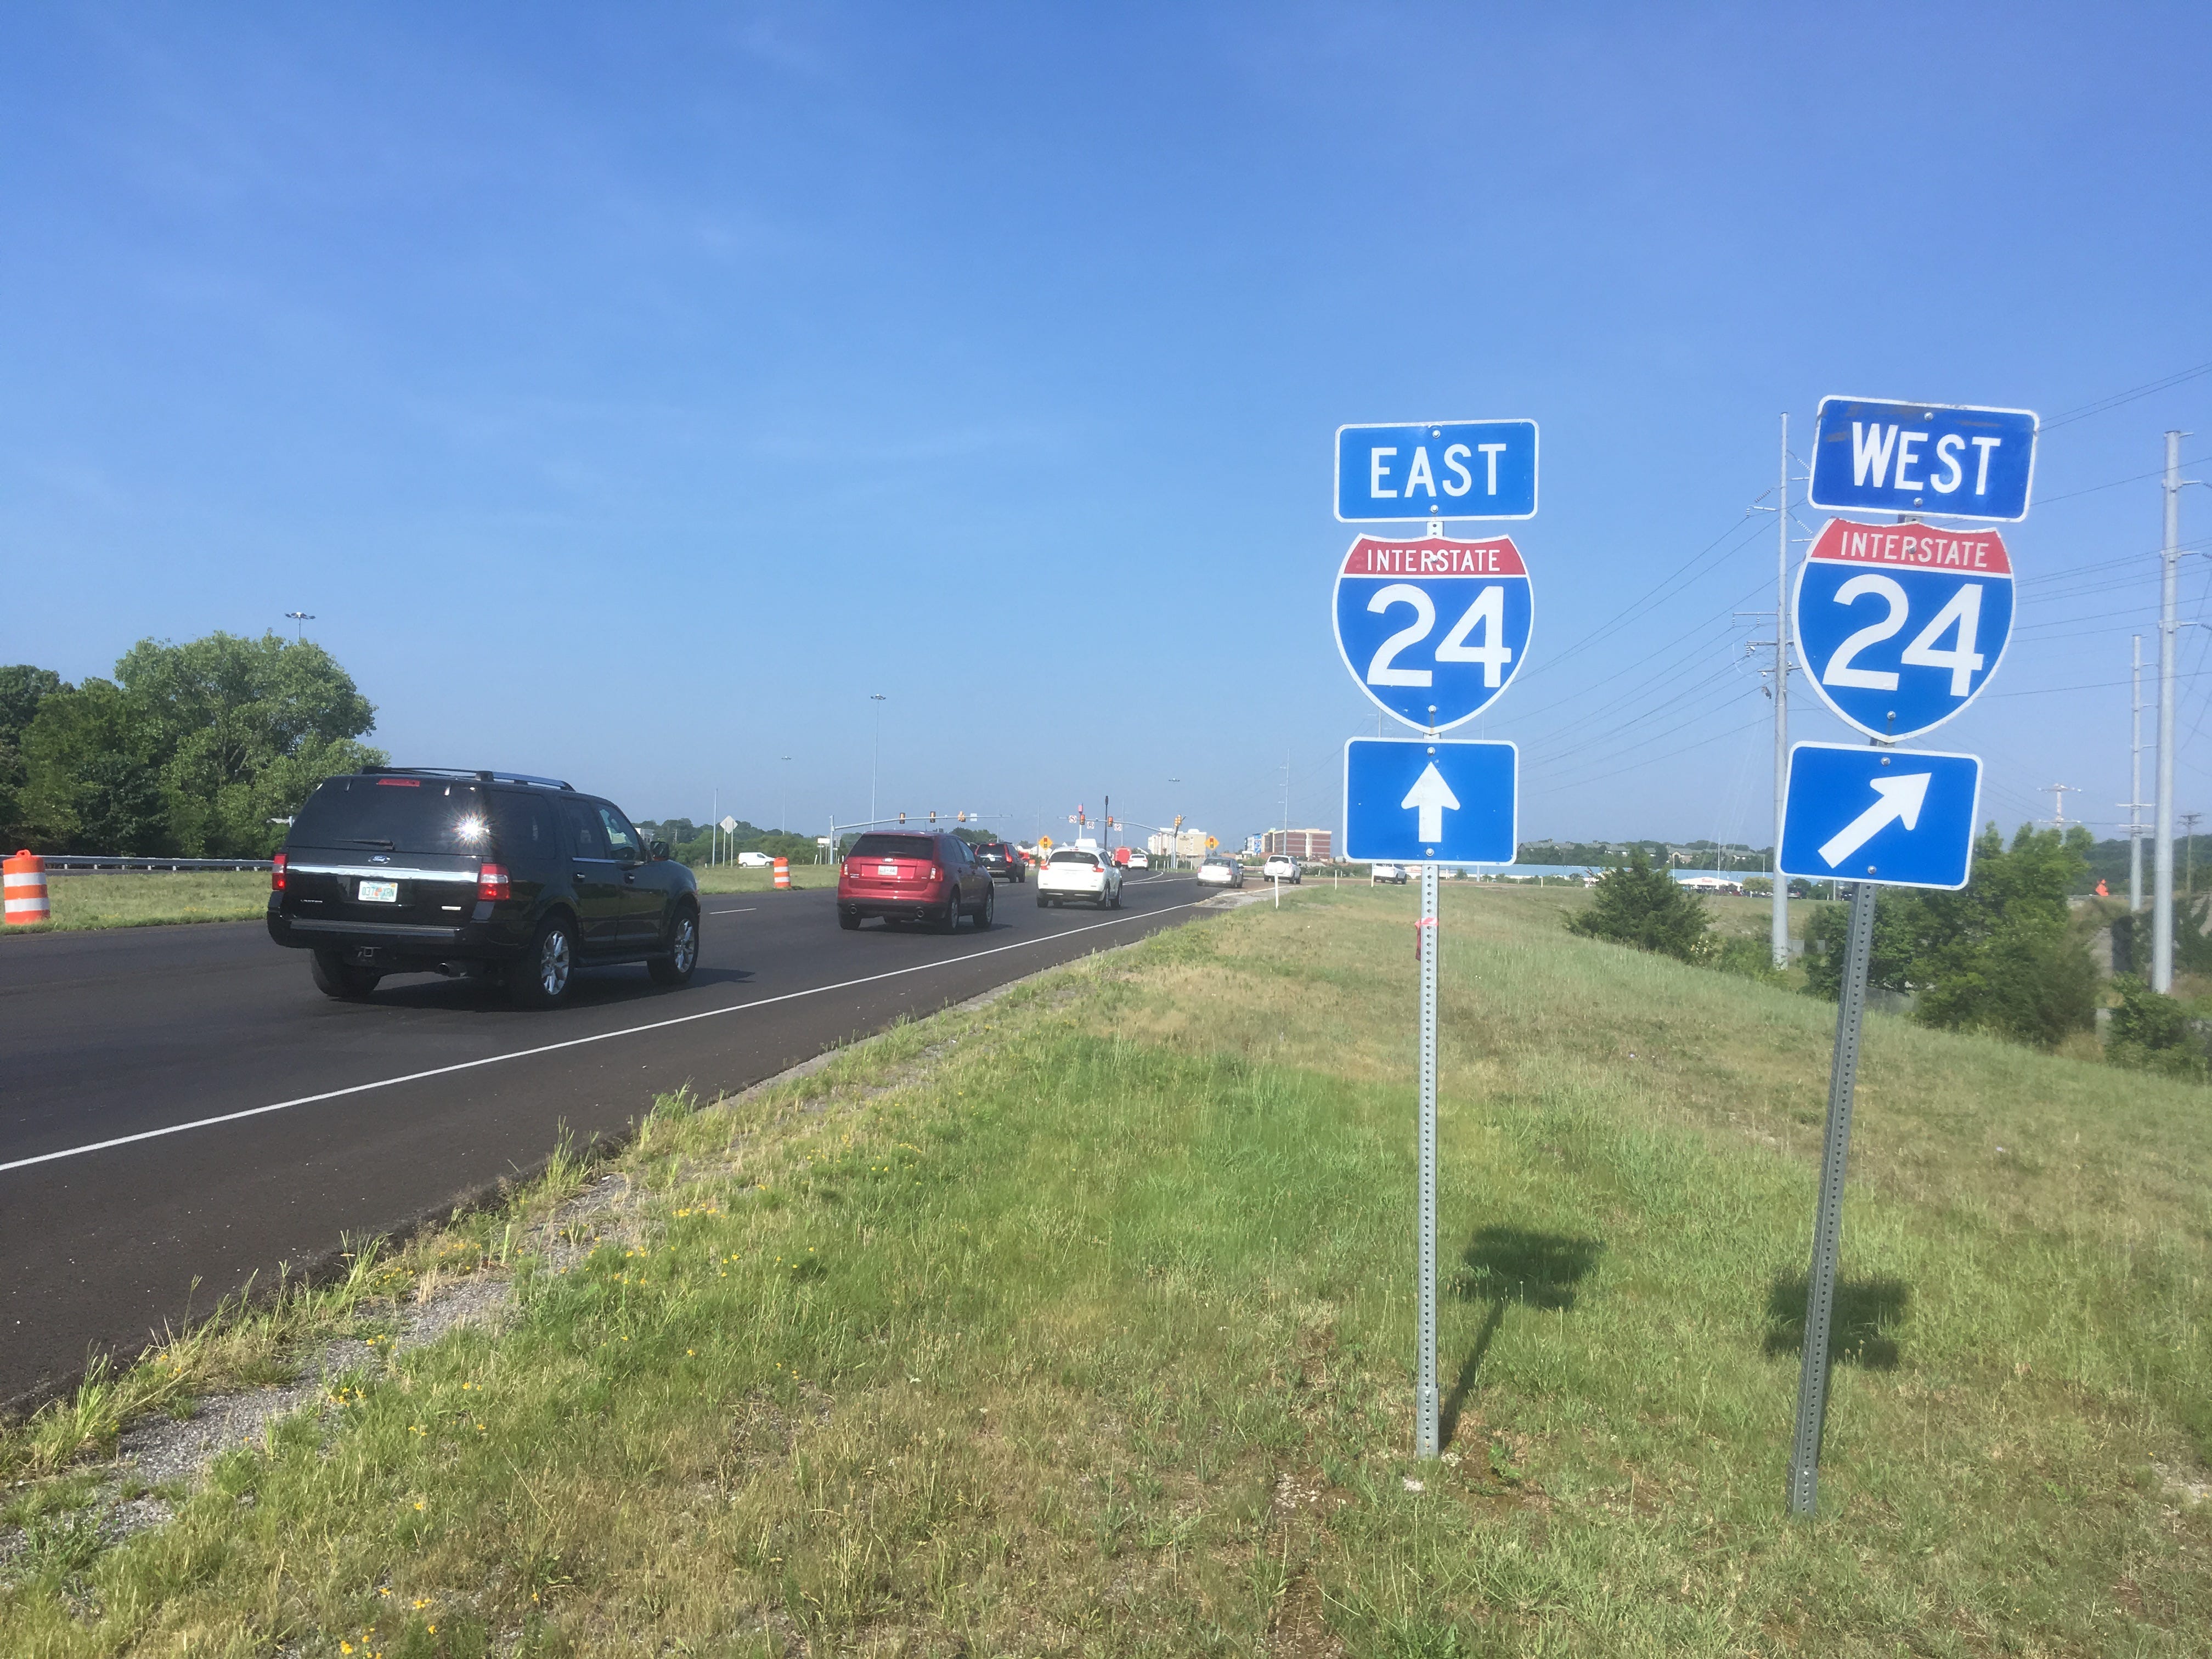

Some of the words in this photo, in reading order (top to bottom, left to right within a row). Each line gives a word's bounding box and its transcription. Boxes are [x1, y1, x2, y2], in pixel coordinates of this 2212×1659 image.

[1370, 443, 1506, 498] EAST
[1852, 422, 2000, 495] WEST
[1368, 549, 1500, 572] INTERSTATE
[1841, 531, 1989, 568] INTERSTATE
[1367, 584, 1511, 687] 24
[1822, 574, 1983, 697] 24
